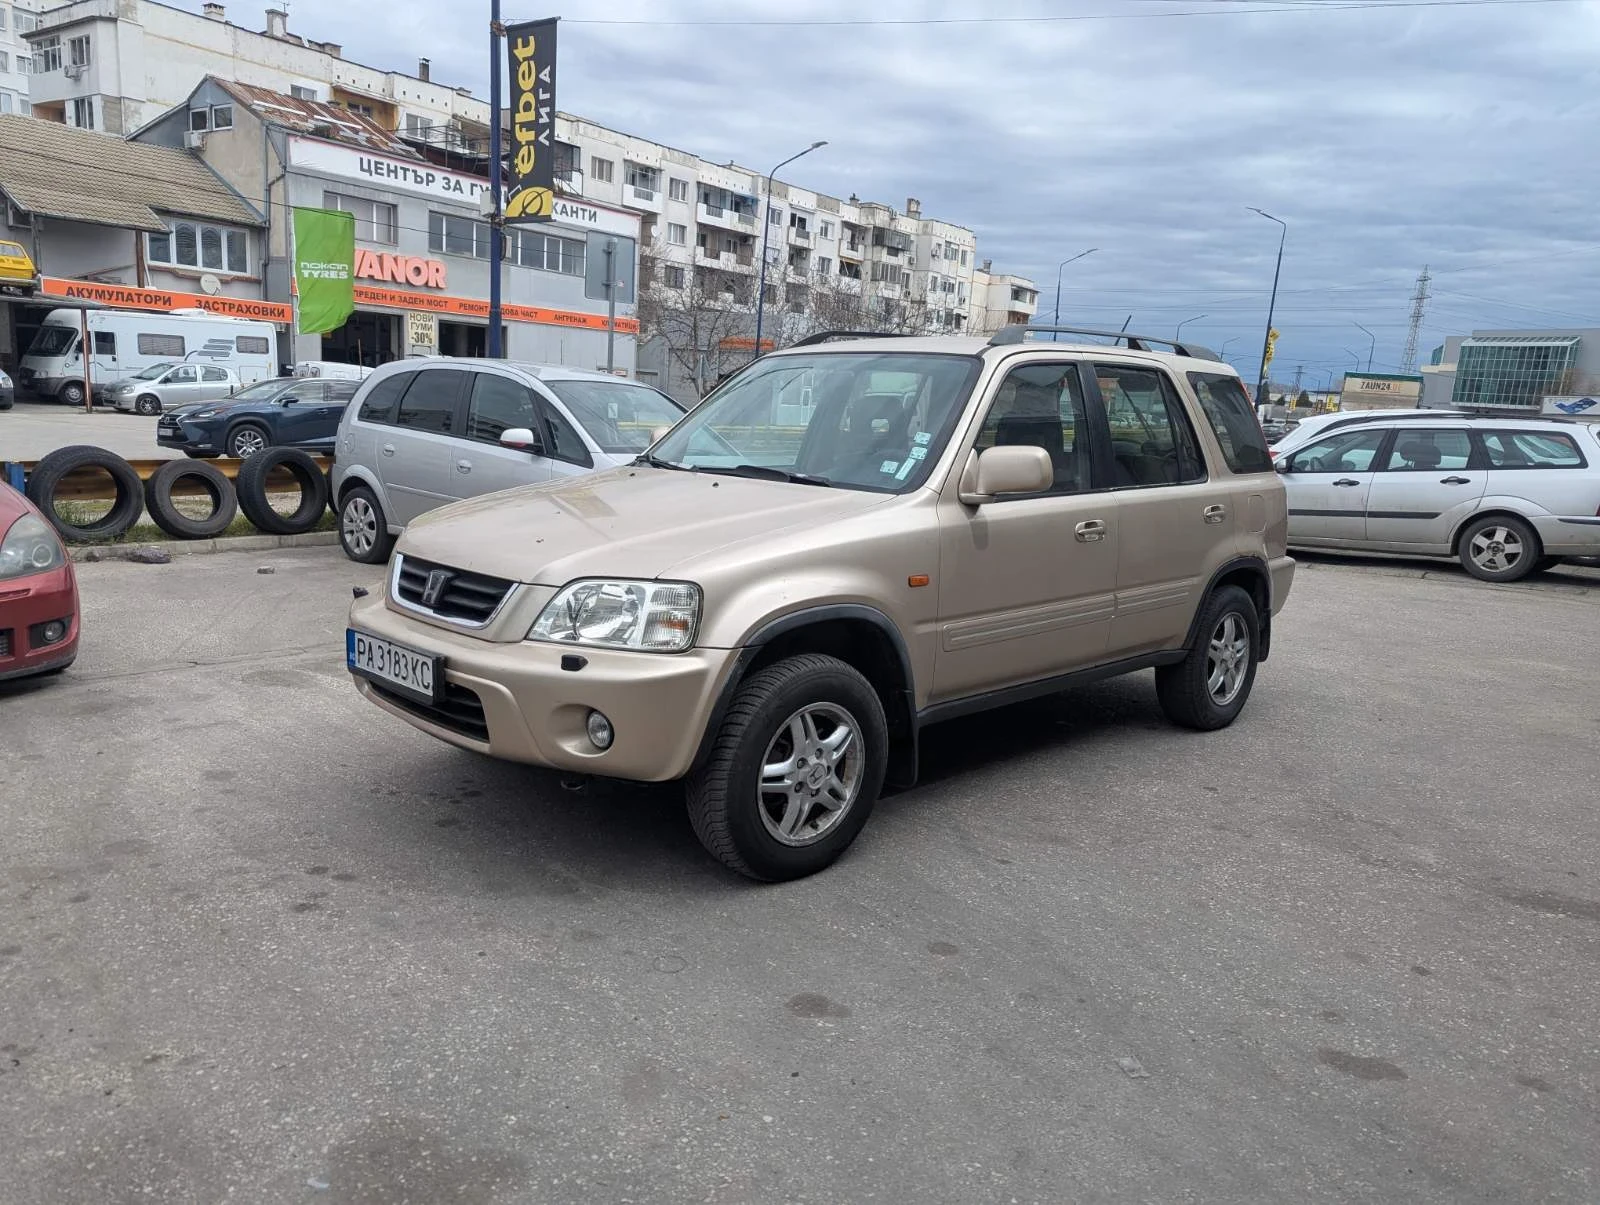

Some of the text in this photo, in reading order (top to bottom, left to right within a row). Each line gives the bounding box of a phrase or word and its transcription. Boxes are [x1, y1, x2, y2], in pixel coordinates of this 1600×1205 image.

[513, 35, 536, 176] efbet
[538, 64, 551, 147] ЛИГА
[359, 156, 436, 188] ЦЕНТЪР
[441, 176, 464, 195] ЗА
[301, 270, 349, 279] TYRES
[65, 285, 286, 318] АКУМУЛАТОРИ ЗАСТРАХОВКИ
[354, 289, 388, 301] ПРЕДЕН
[389, 293, 396, 302] И
[398, 295, 425, 305] ЗАДЕН
[426, 299, 449, 309] МОСТ
[458, 302, 489, 313] РЕМОНТ
[553, 313, 587, 324] АНГРЕНАЖ
[409, 312, 434, 322] НОВИ
[410, 321, 433, 333] ГУМИ
[410, 332, 433, 345] -30%
